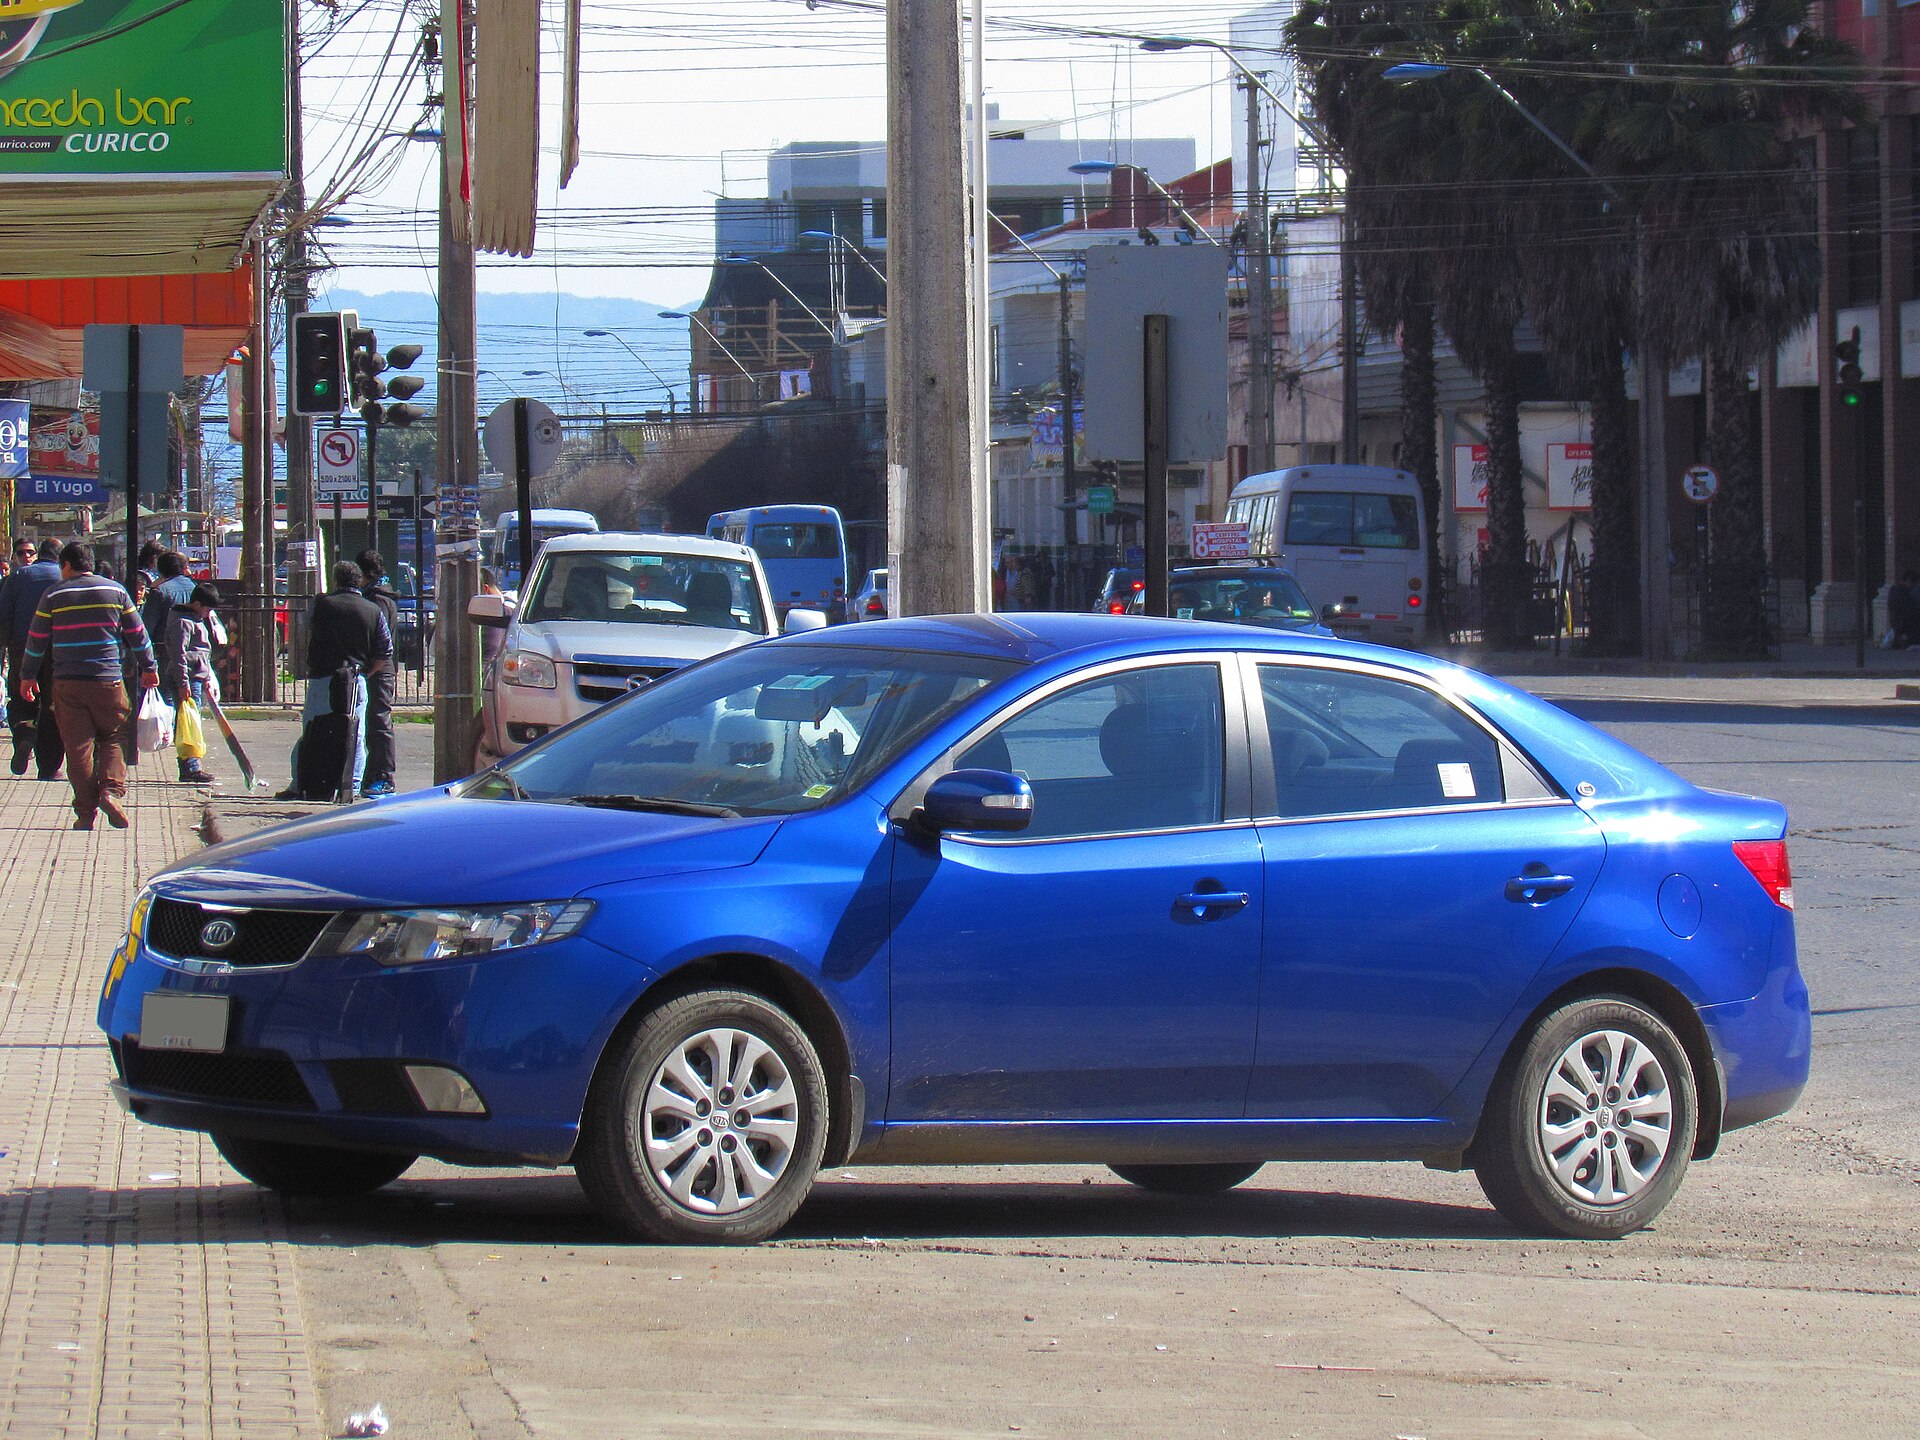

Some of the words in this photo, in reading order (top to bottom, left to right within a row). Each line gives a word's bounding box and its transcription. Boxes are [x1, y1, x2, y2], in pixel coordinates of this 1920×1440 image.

[115, 88, 192, 126] bar
[65, 132, 170, 153] CURICO
[35, 480, 48, 494] El
[52, 480, 93, 496] Yugo
[1195, 532, 1209, 557] 8
[205, 926, 228, 942] KIA
